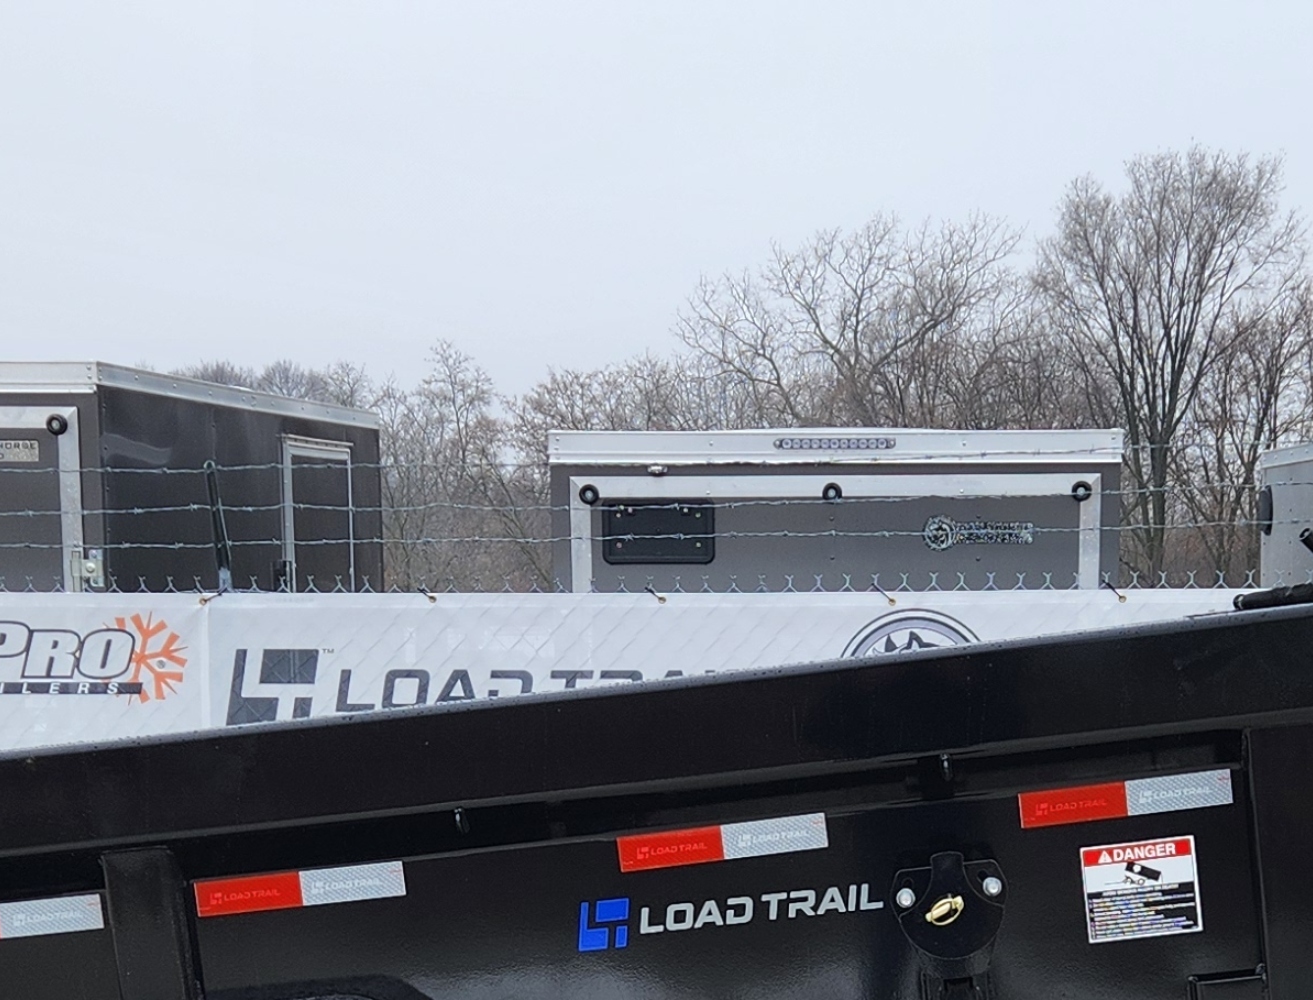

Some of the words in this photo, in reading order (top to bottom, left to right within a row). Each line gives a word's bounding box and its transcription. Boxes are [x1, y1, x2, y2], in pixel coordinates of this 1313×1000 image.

[1112, 842, 1177, 862] DANGER
[639, 896, 755, 935] LOAD
[760, 883, 885, 921] TRAIL
